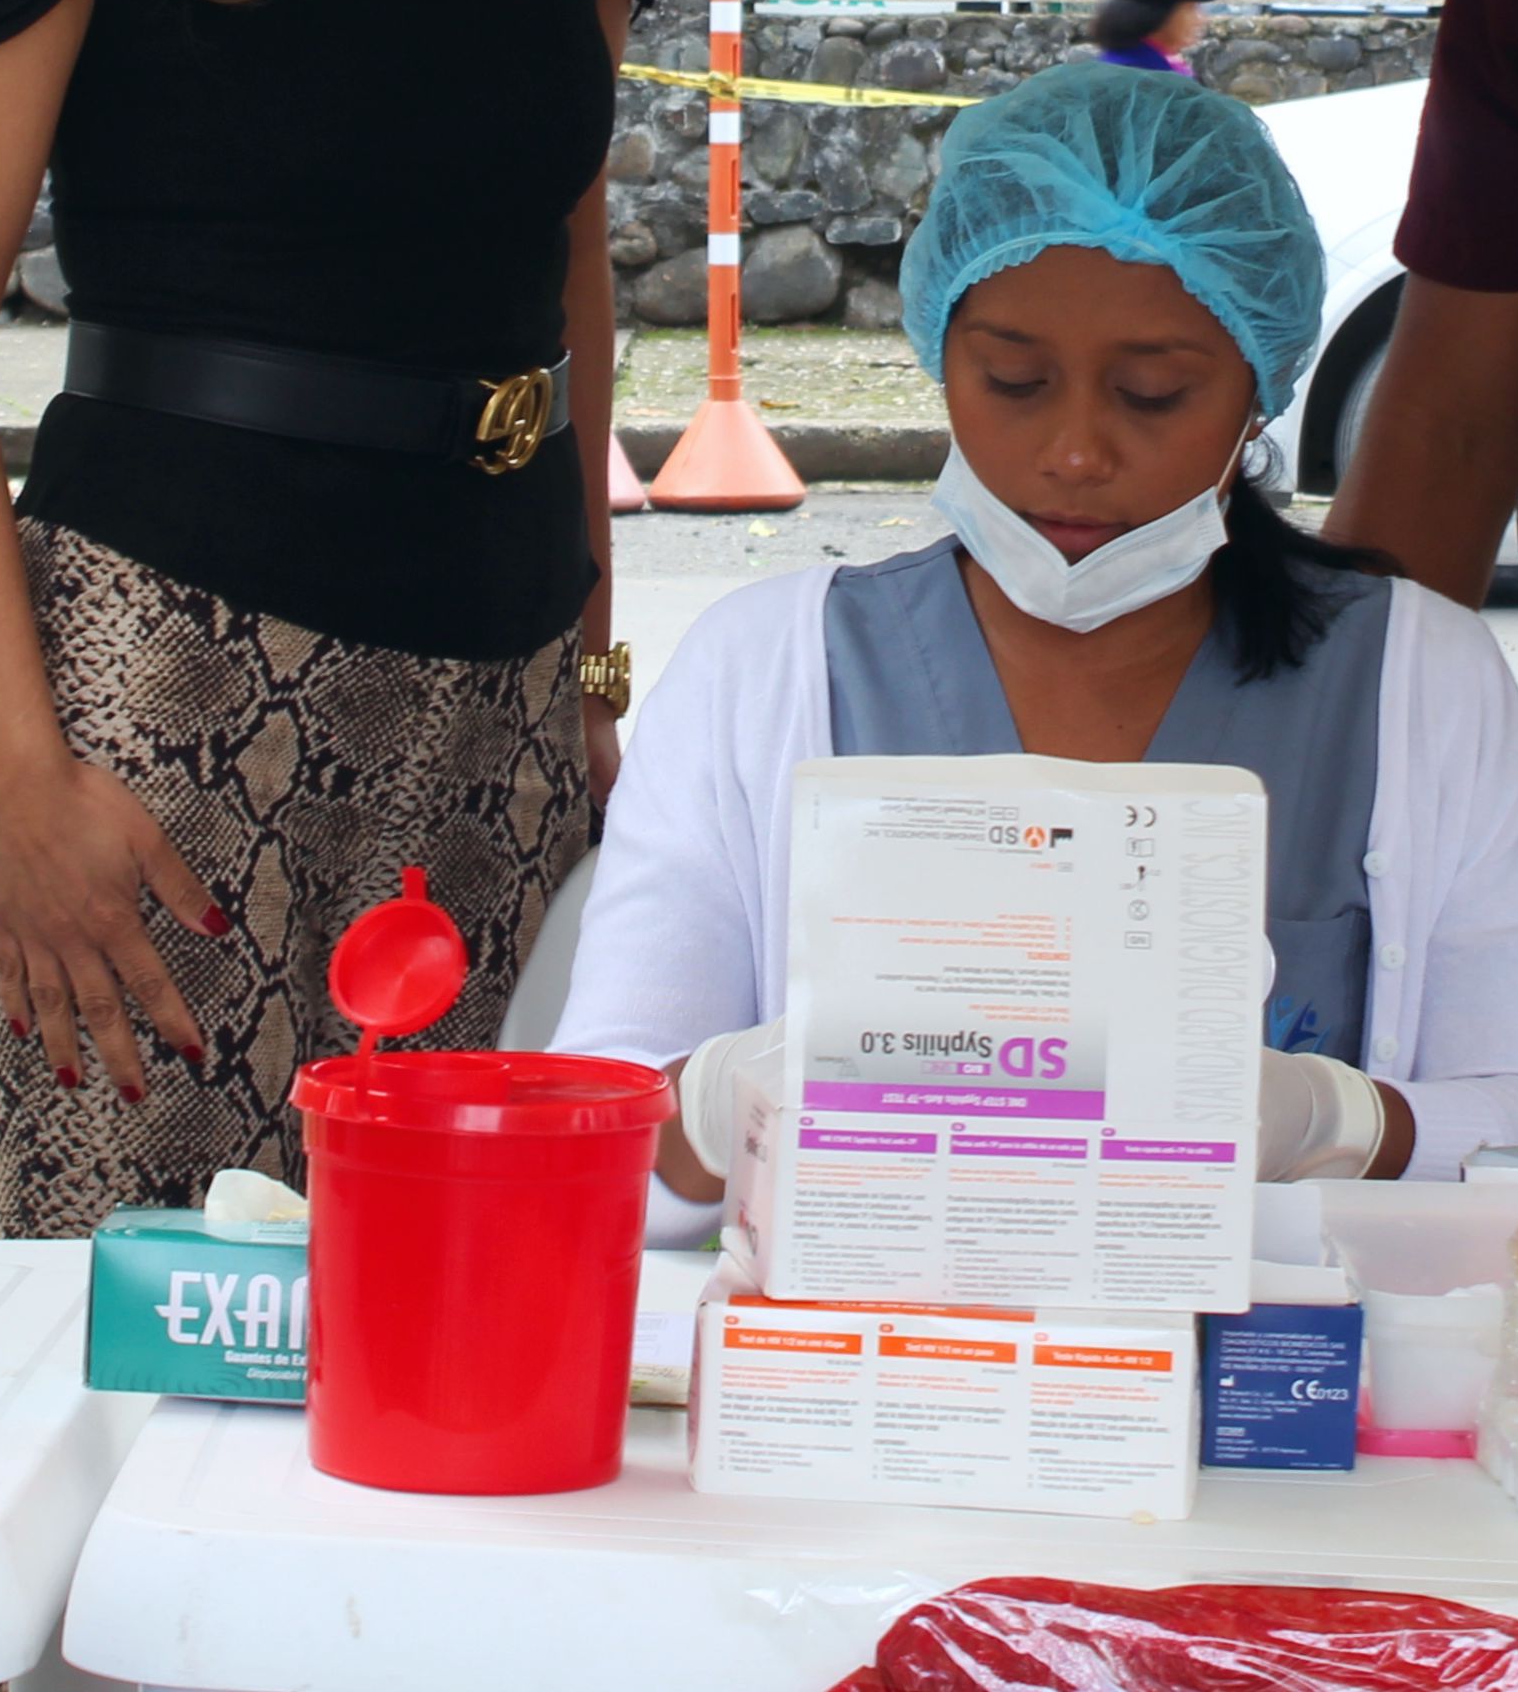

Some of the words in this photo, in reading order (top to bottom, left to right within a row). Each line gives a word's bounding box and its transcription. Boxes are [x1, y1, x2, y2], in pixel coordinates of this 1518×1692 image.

[989, 825, 1020, 846] SD
[860, 1031, 895, 1055] 3.0
[902, 1030, 993, 1059] Syphilis
[998, 1037, 1068, 1081] SD
[738, 1333, 756, 1344] Test
[905, 1342, 923, 1353] Test
[224, 1349, 273, 1365] Guantes
[273, 1352, 290, 1366] de
